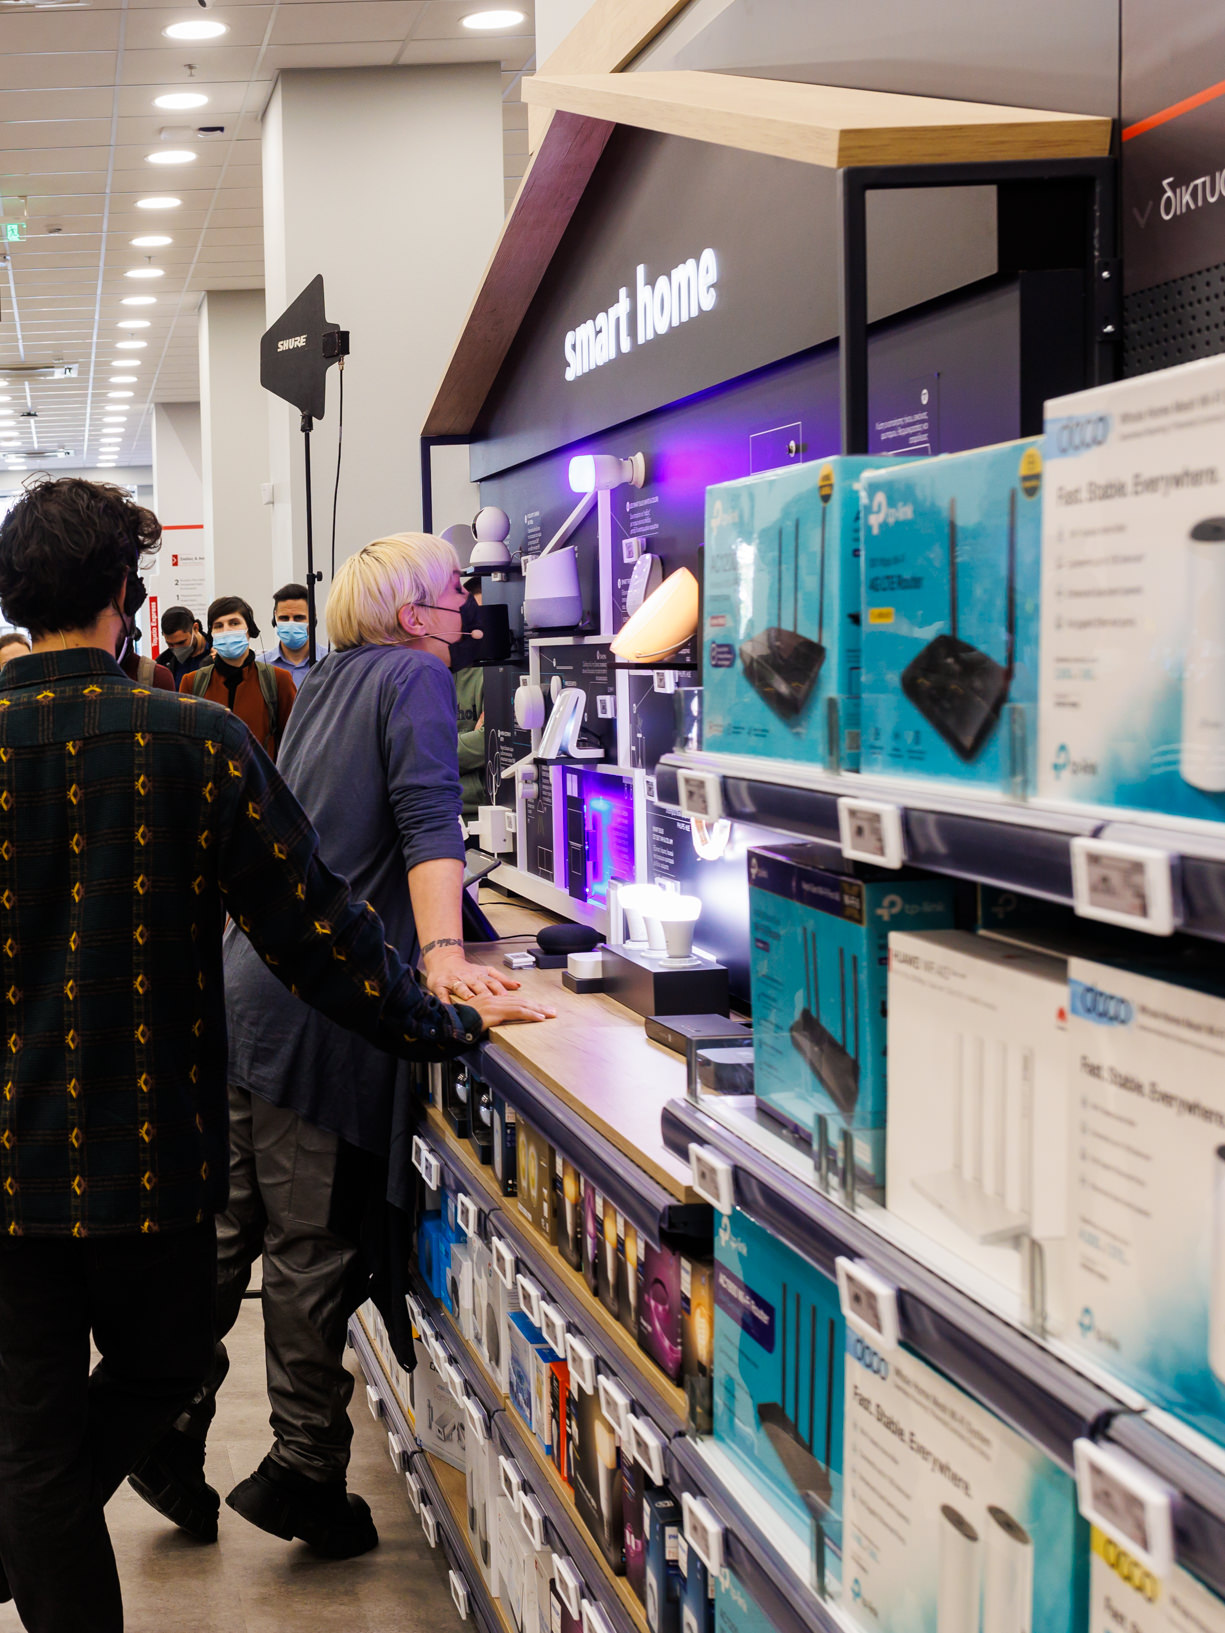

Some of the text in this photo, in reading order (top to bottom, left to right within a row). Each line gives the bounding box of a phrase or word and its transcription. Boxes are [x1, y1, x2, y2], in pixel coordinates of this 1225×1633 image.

[277, 334, 308, 352] SHURE
[564, 247, 717, 381] smart home
